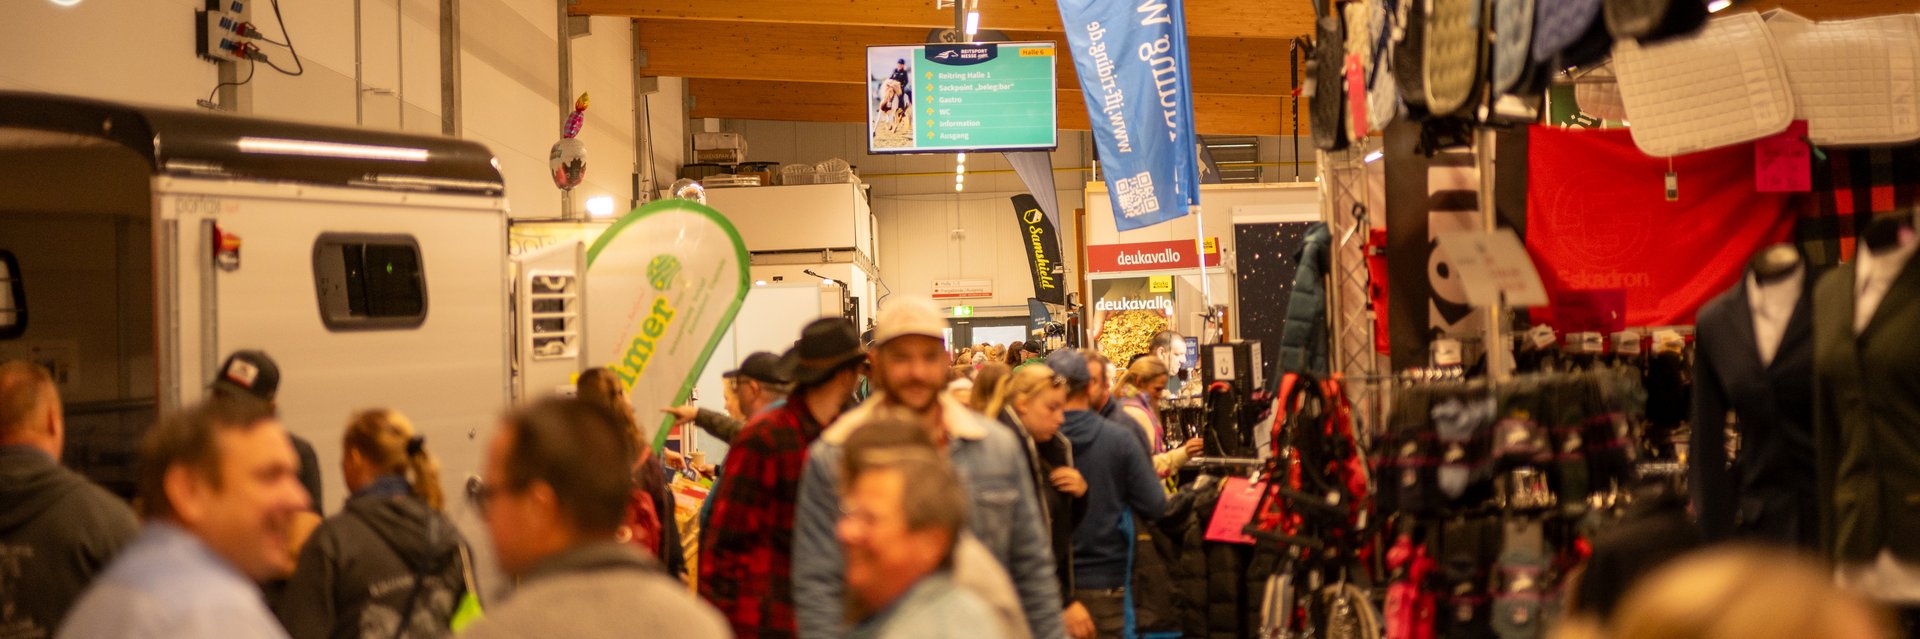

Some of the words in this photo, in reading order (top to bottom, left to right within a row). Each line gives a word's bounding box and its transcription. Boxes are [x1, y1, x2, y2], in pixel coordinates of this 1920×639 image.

[939, 72, 966, 80] Reitring
[1029, 225, 1055, 290] Samshield
[1117, 248, 1181, 266] deukavallo
[1095, 296, 1173, 311] deukavallo
